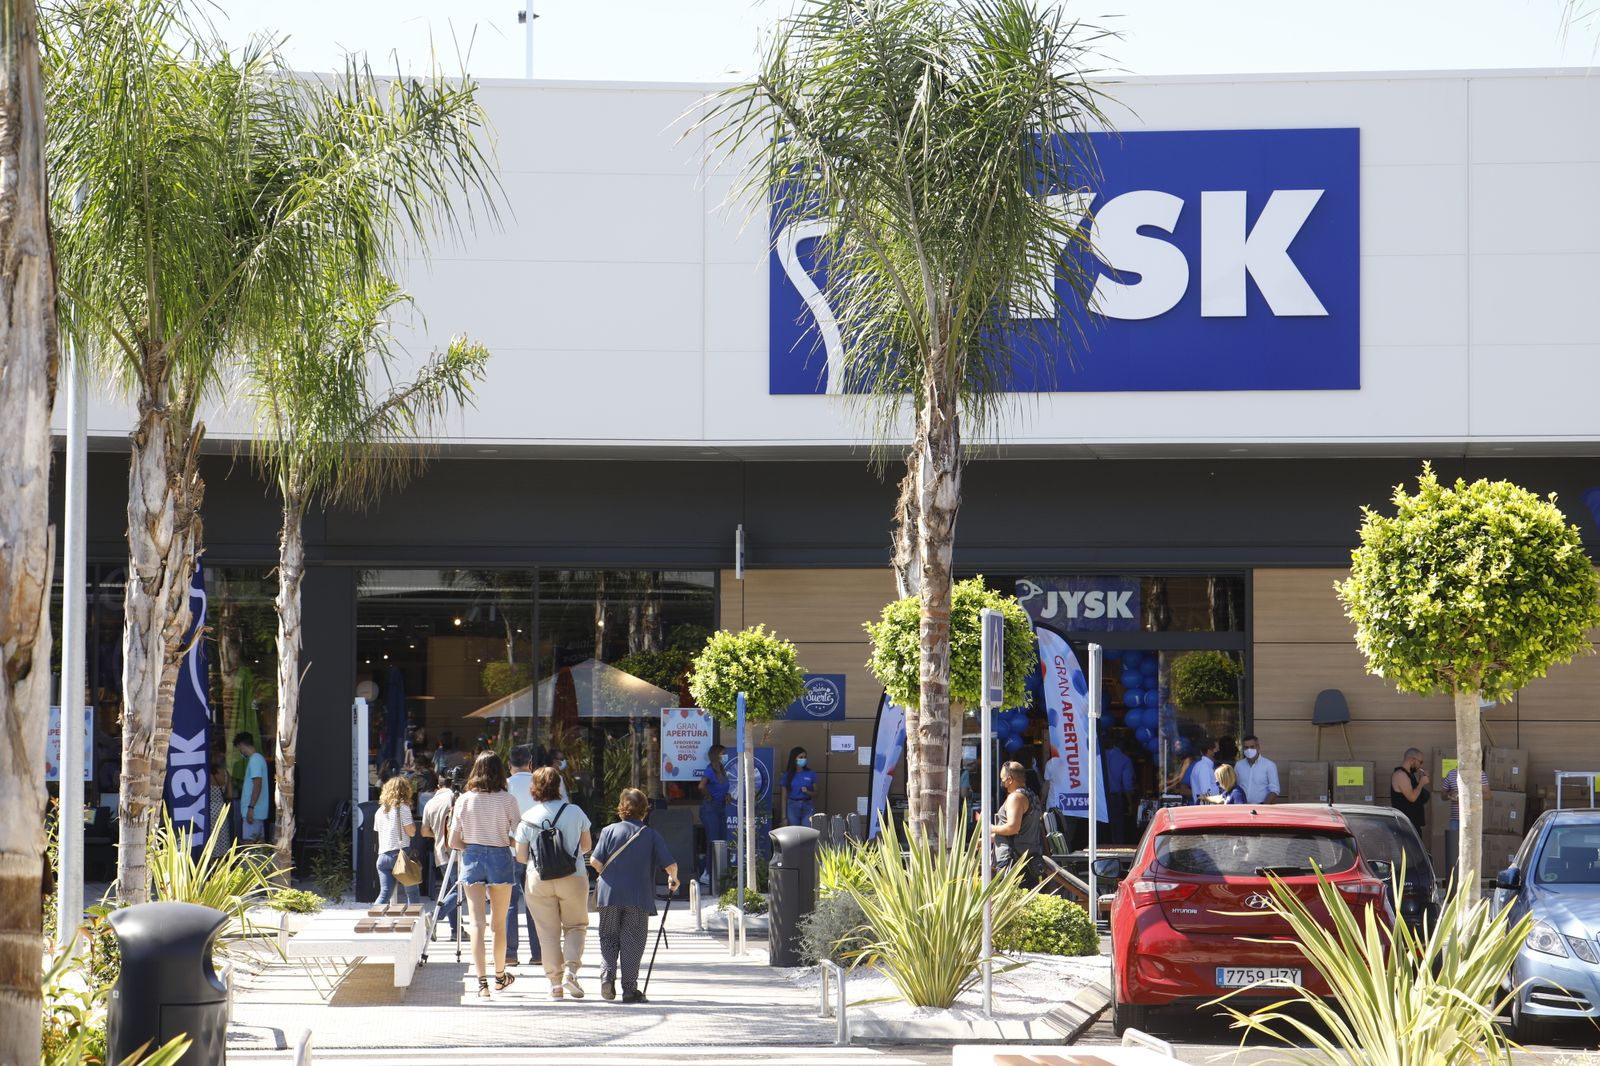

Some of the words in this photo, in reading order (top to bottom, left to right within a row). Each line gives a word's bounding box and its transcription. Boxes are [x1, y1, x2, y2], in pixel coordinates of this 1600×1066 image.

[990, 188, 1329, 320] YSK
[1040, 590, 1135, 619] JYSK
[1053, 654, 1071, 698] GRAN
[806, 689, 833, 702] Suerte
[666, 729, 708, 737] APERTURA
[676, 722, 698, 730] GRAN
[1060, 700, 1082, 790] APERTURA
[677, 753, 697, 761] 80%
[1226, 970, 1265, 984] 7759
[1270, 970, 1298, 984] HZY
